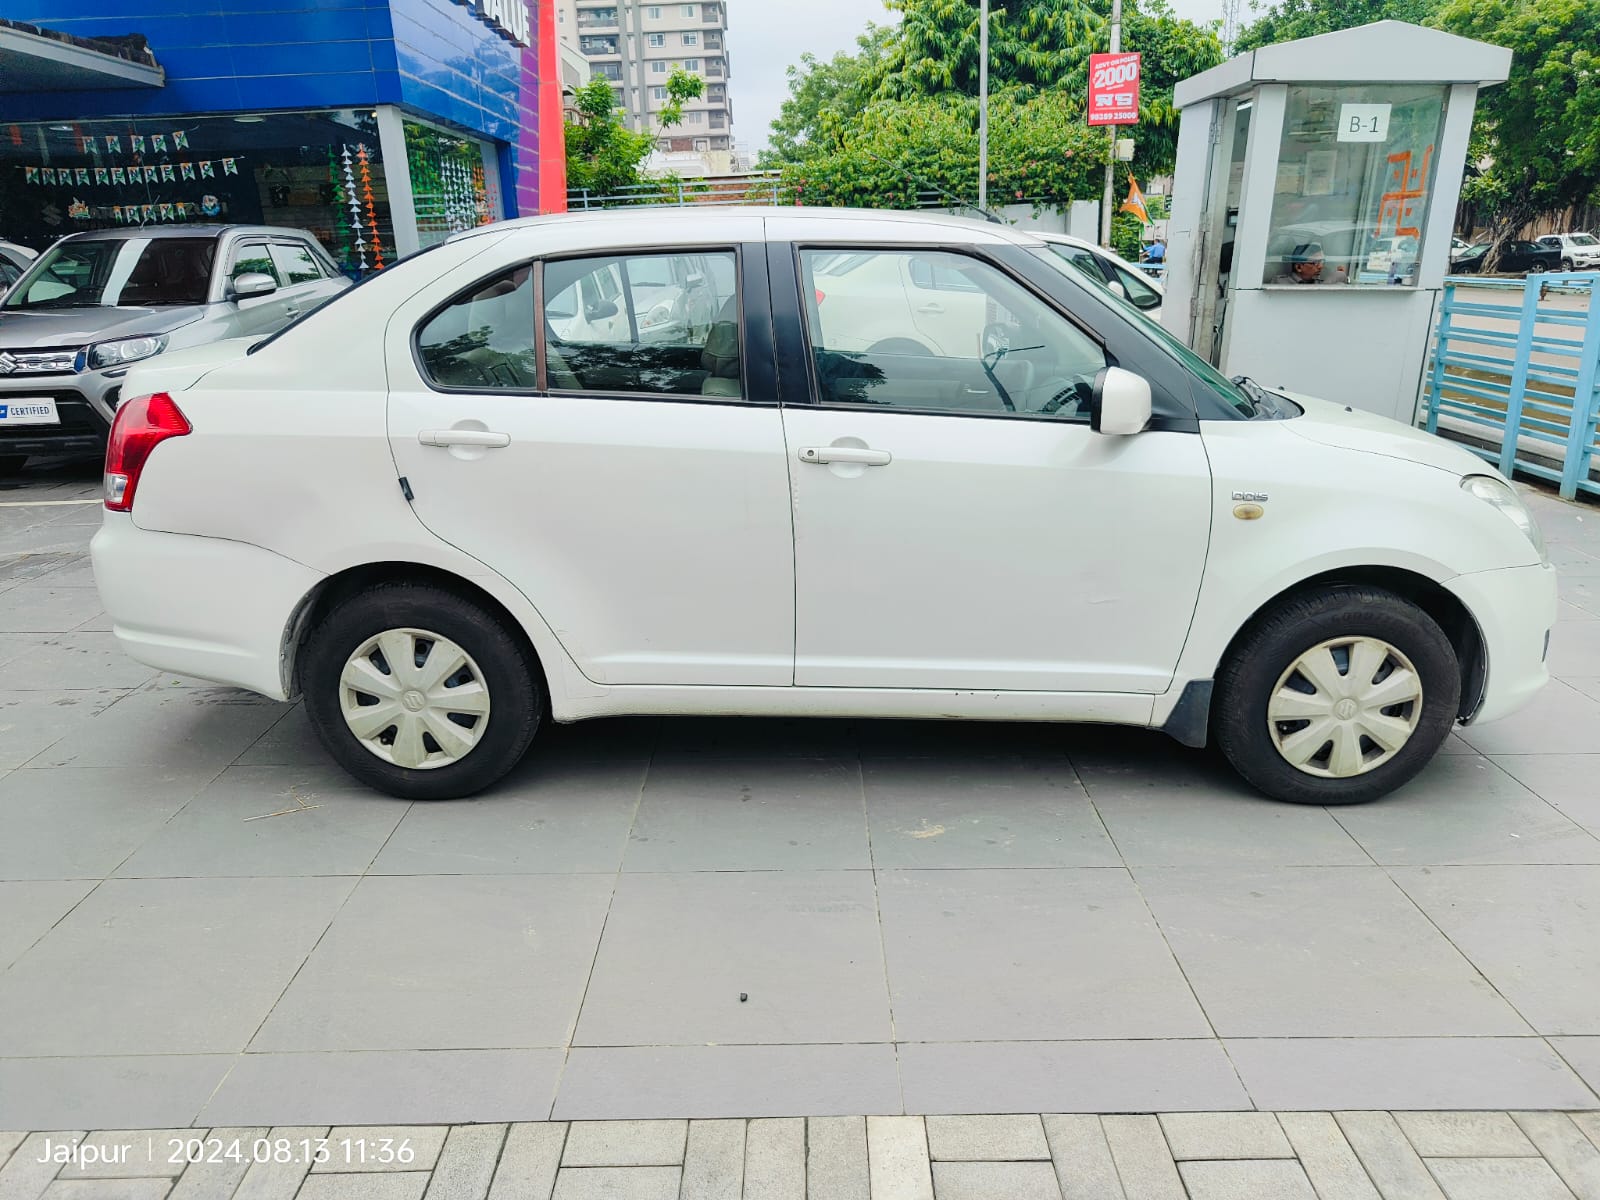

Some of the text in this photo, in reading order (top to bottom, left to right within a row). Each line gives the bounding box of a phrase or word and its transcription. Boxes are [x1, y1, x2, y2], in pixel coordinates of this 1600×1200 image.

[466, 0, 531, 47] ALUE
[1349, 116, 1379, 133] B-1
[85, 132, 187, 149] HAPPY
[128, 206, 172, 219] DAY
[10, 406, 50, 416] CERTIFIED
